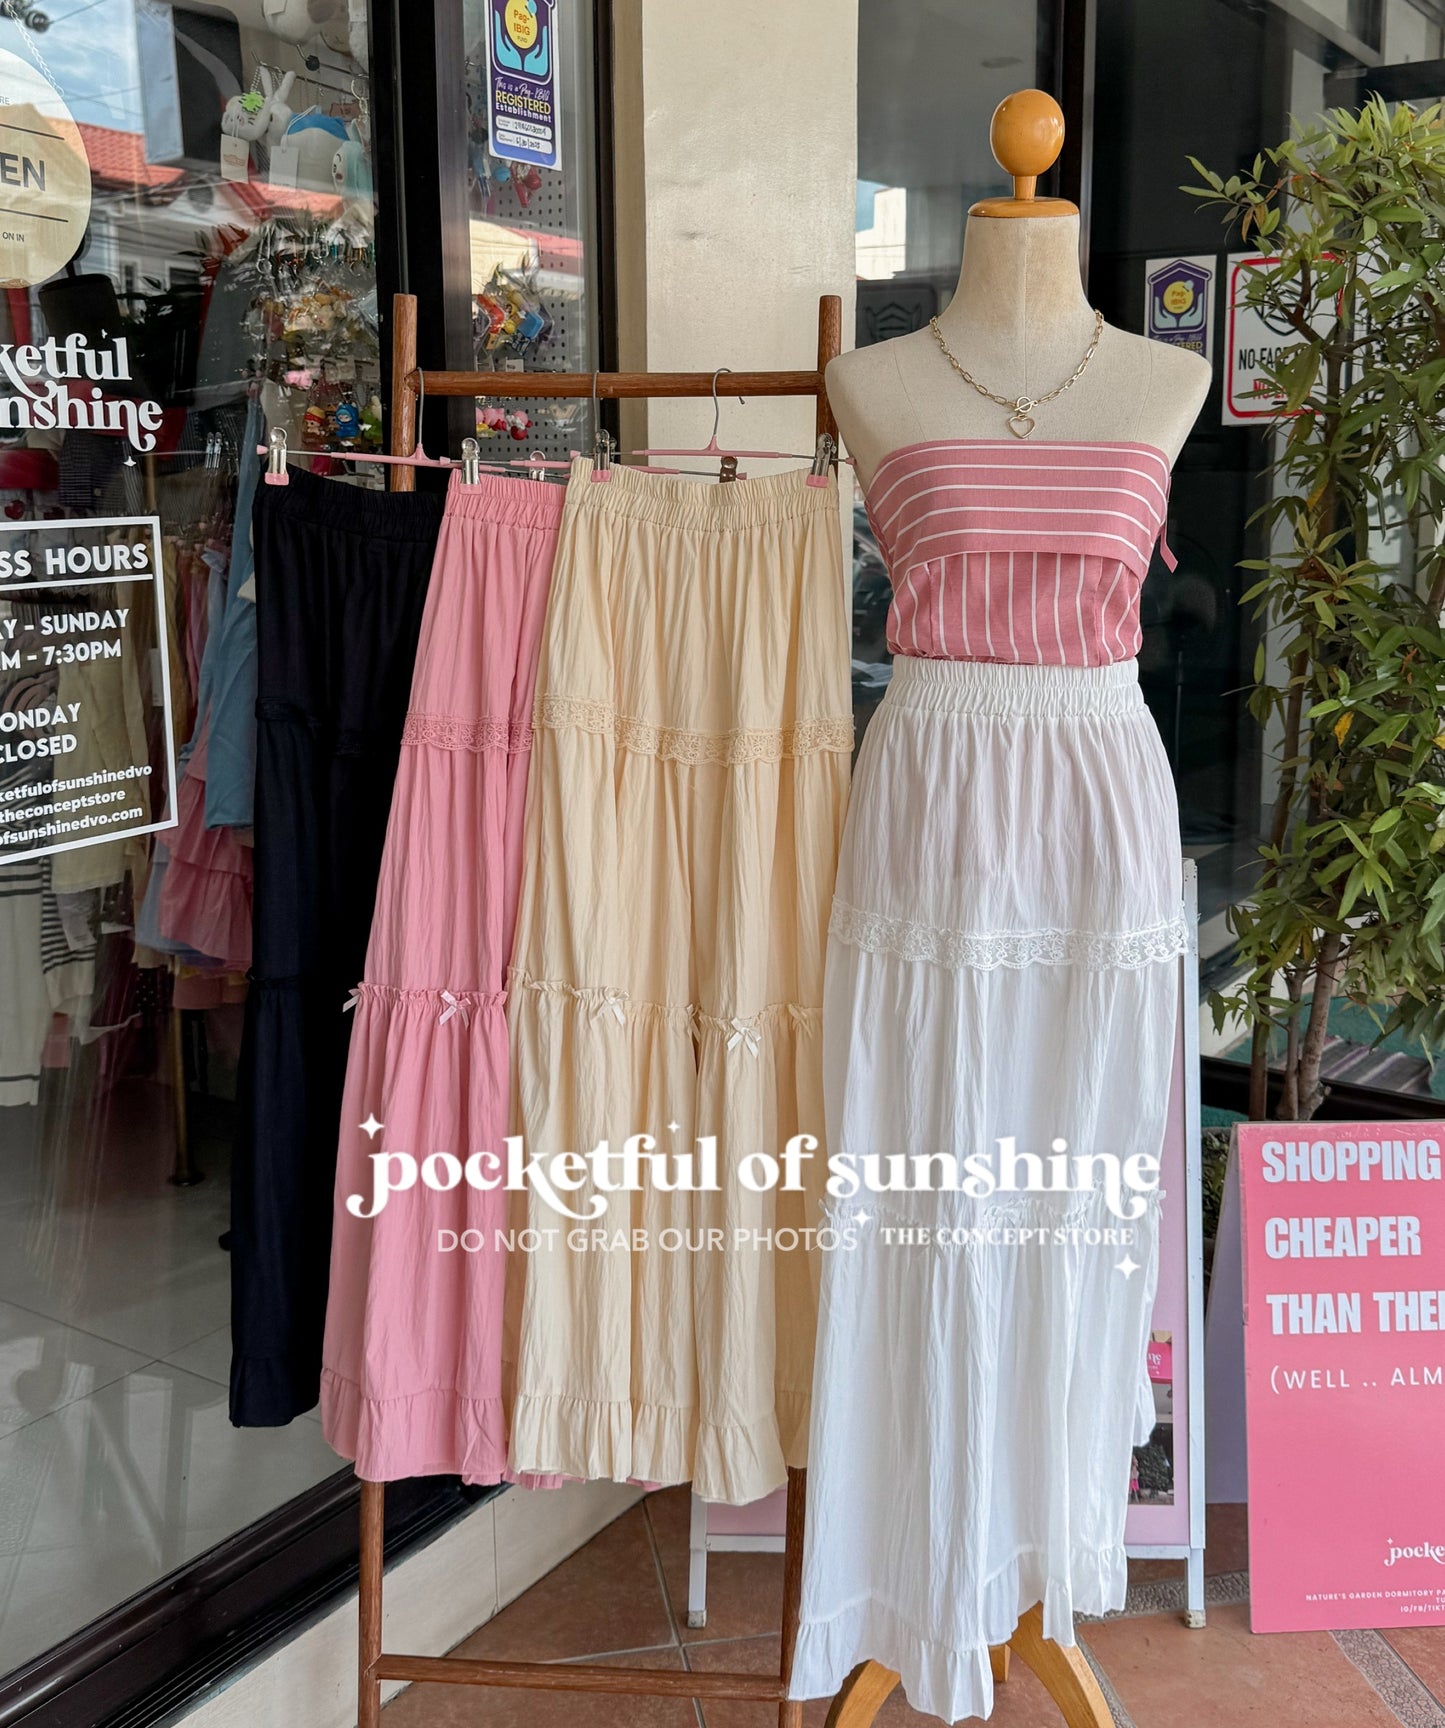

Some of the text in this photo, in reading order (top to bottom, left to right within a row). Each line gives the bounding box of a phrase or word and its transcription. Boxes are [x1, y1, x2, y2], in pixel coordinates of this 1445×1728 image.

[513, 22, 531, 36] IBIG
[495, 90, 551, 115] REGISTERED
[495, 102, 552, 123] Establishment
[0, 152, 46, 192] EN
[2, 231, 25, 242] ON IN
[1239, 348, 1256, 370] NO
[0, 384, 163, 452] nshine
[0, 543, 149, 579] SS HOURS
[40, 608, 129, 636] SUNDAY
[42, 639, 121, 666] 7:30PM
[0, 702, 81, 733] ONDAY
[1262, 1139, 1442, 1183] SHOPPING
[1264, 1216, 1422, 1259] CHEAPER
[1266, 1293, 1361, 1335] THAN
[1270, 1365, 1350, 1394] (WELL
[1391, 1366, 1443, 1386] ALM
[1305, 1593, 1347, 1601] NATURE'S
[1349, 1591, 1382, 1600] GARDEN
[1385, 1589, 1433, 1598] DORMITORY
